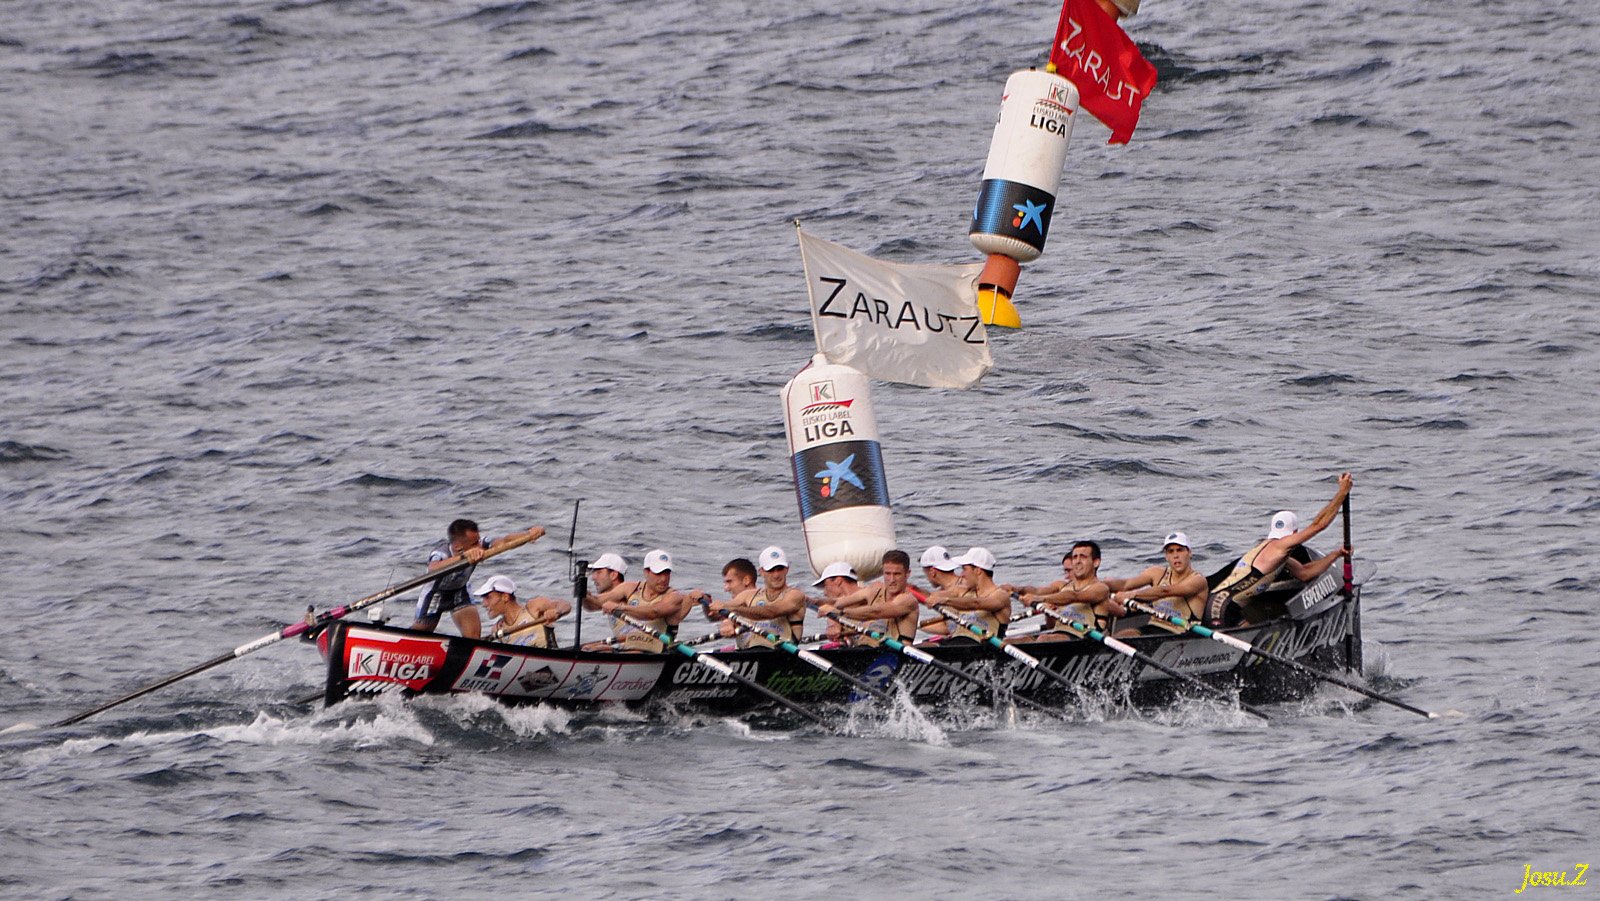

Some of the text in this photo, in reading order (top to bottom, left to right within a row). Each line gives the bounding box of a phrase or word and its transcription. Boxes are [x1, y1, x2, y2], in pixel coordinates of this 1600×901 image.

[1030, 114, 1066, 138] LIGA
[818, 276, 985, 344] ZARAUTZ
[803, 410, 852, 426] EUSKO LABEL
[804, 420, 854, 443] LIGA
[1273, 607, 1348, 661] INDAU
[381, 651, 435, 665] EUSKO LABEL
[378, 661, 430, 680] LIGA
[672, 661, 760, 685] GETARIA
[1000, 656, 1057, 690] SAN
